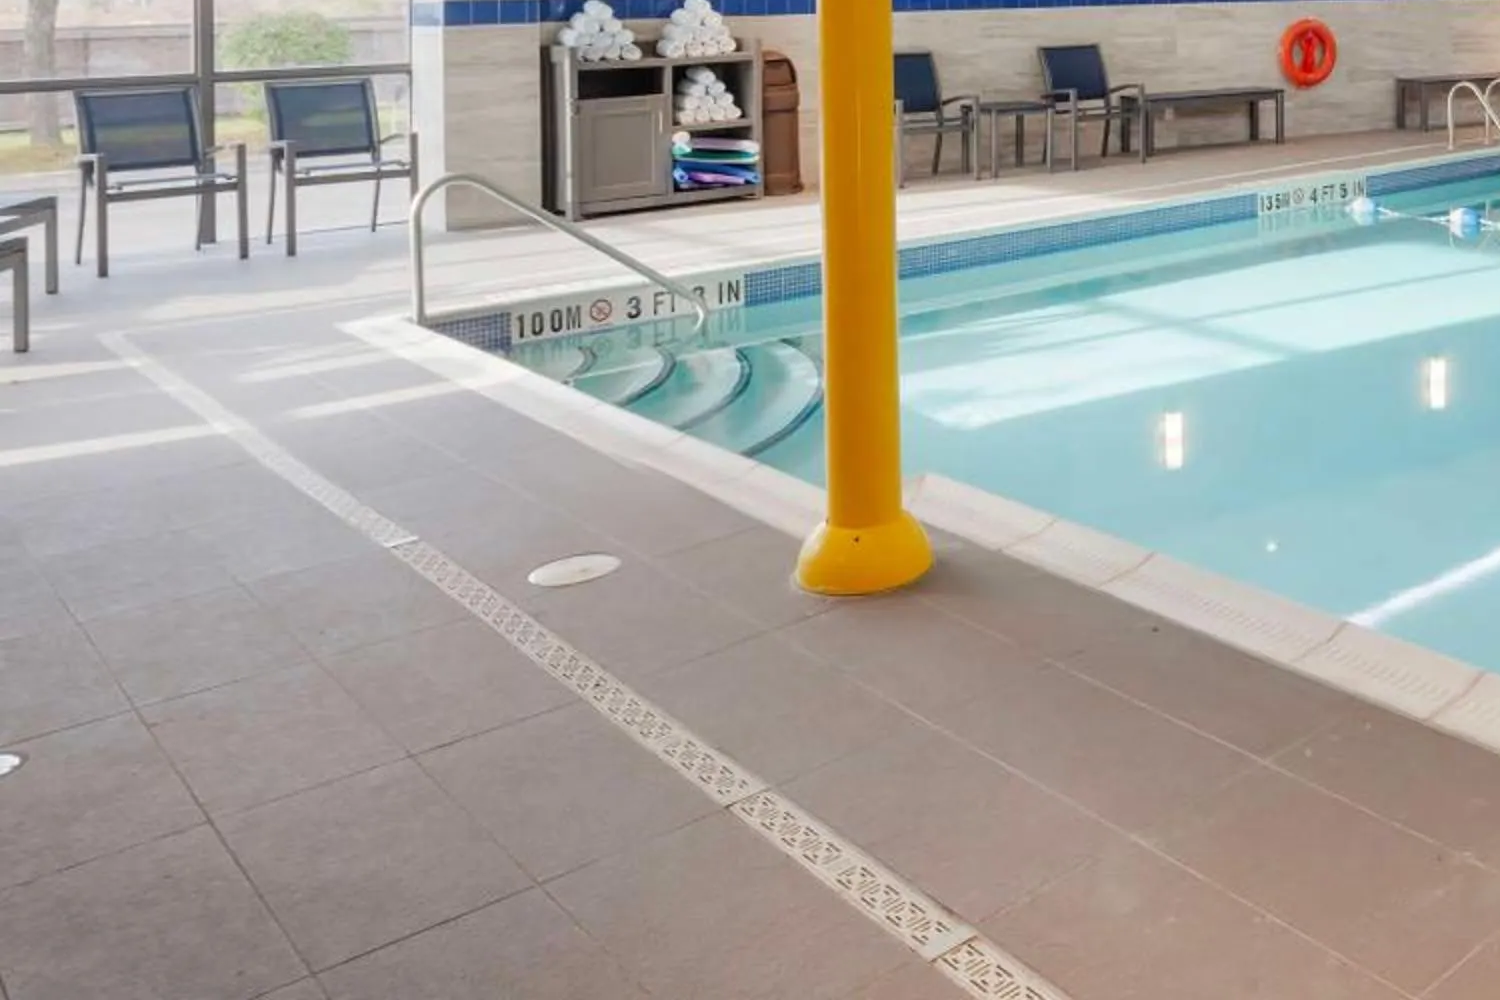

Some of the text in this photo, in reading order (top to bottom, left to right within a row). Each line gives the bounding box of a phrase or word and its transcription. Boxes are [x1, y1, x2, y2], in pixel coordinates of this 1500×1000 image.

[1310, 187, 1318, 204] 4
[1322, 183, 1335, 202] FT
[1340, 183, 1348, 199] 5
[1353, 179, 1365, 197] IN
[515, 304, 582, 339] 100M
[627, 296, 642, 319] 3
[653, 290, 675, 315] FT
[718, 279, 740, 304] IN
